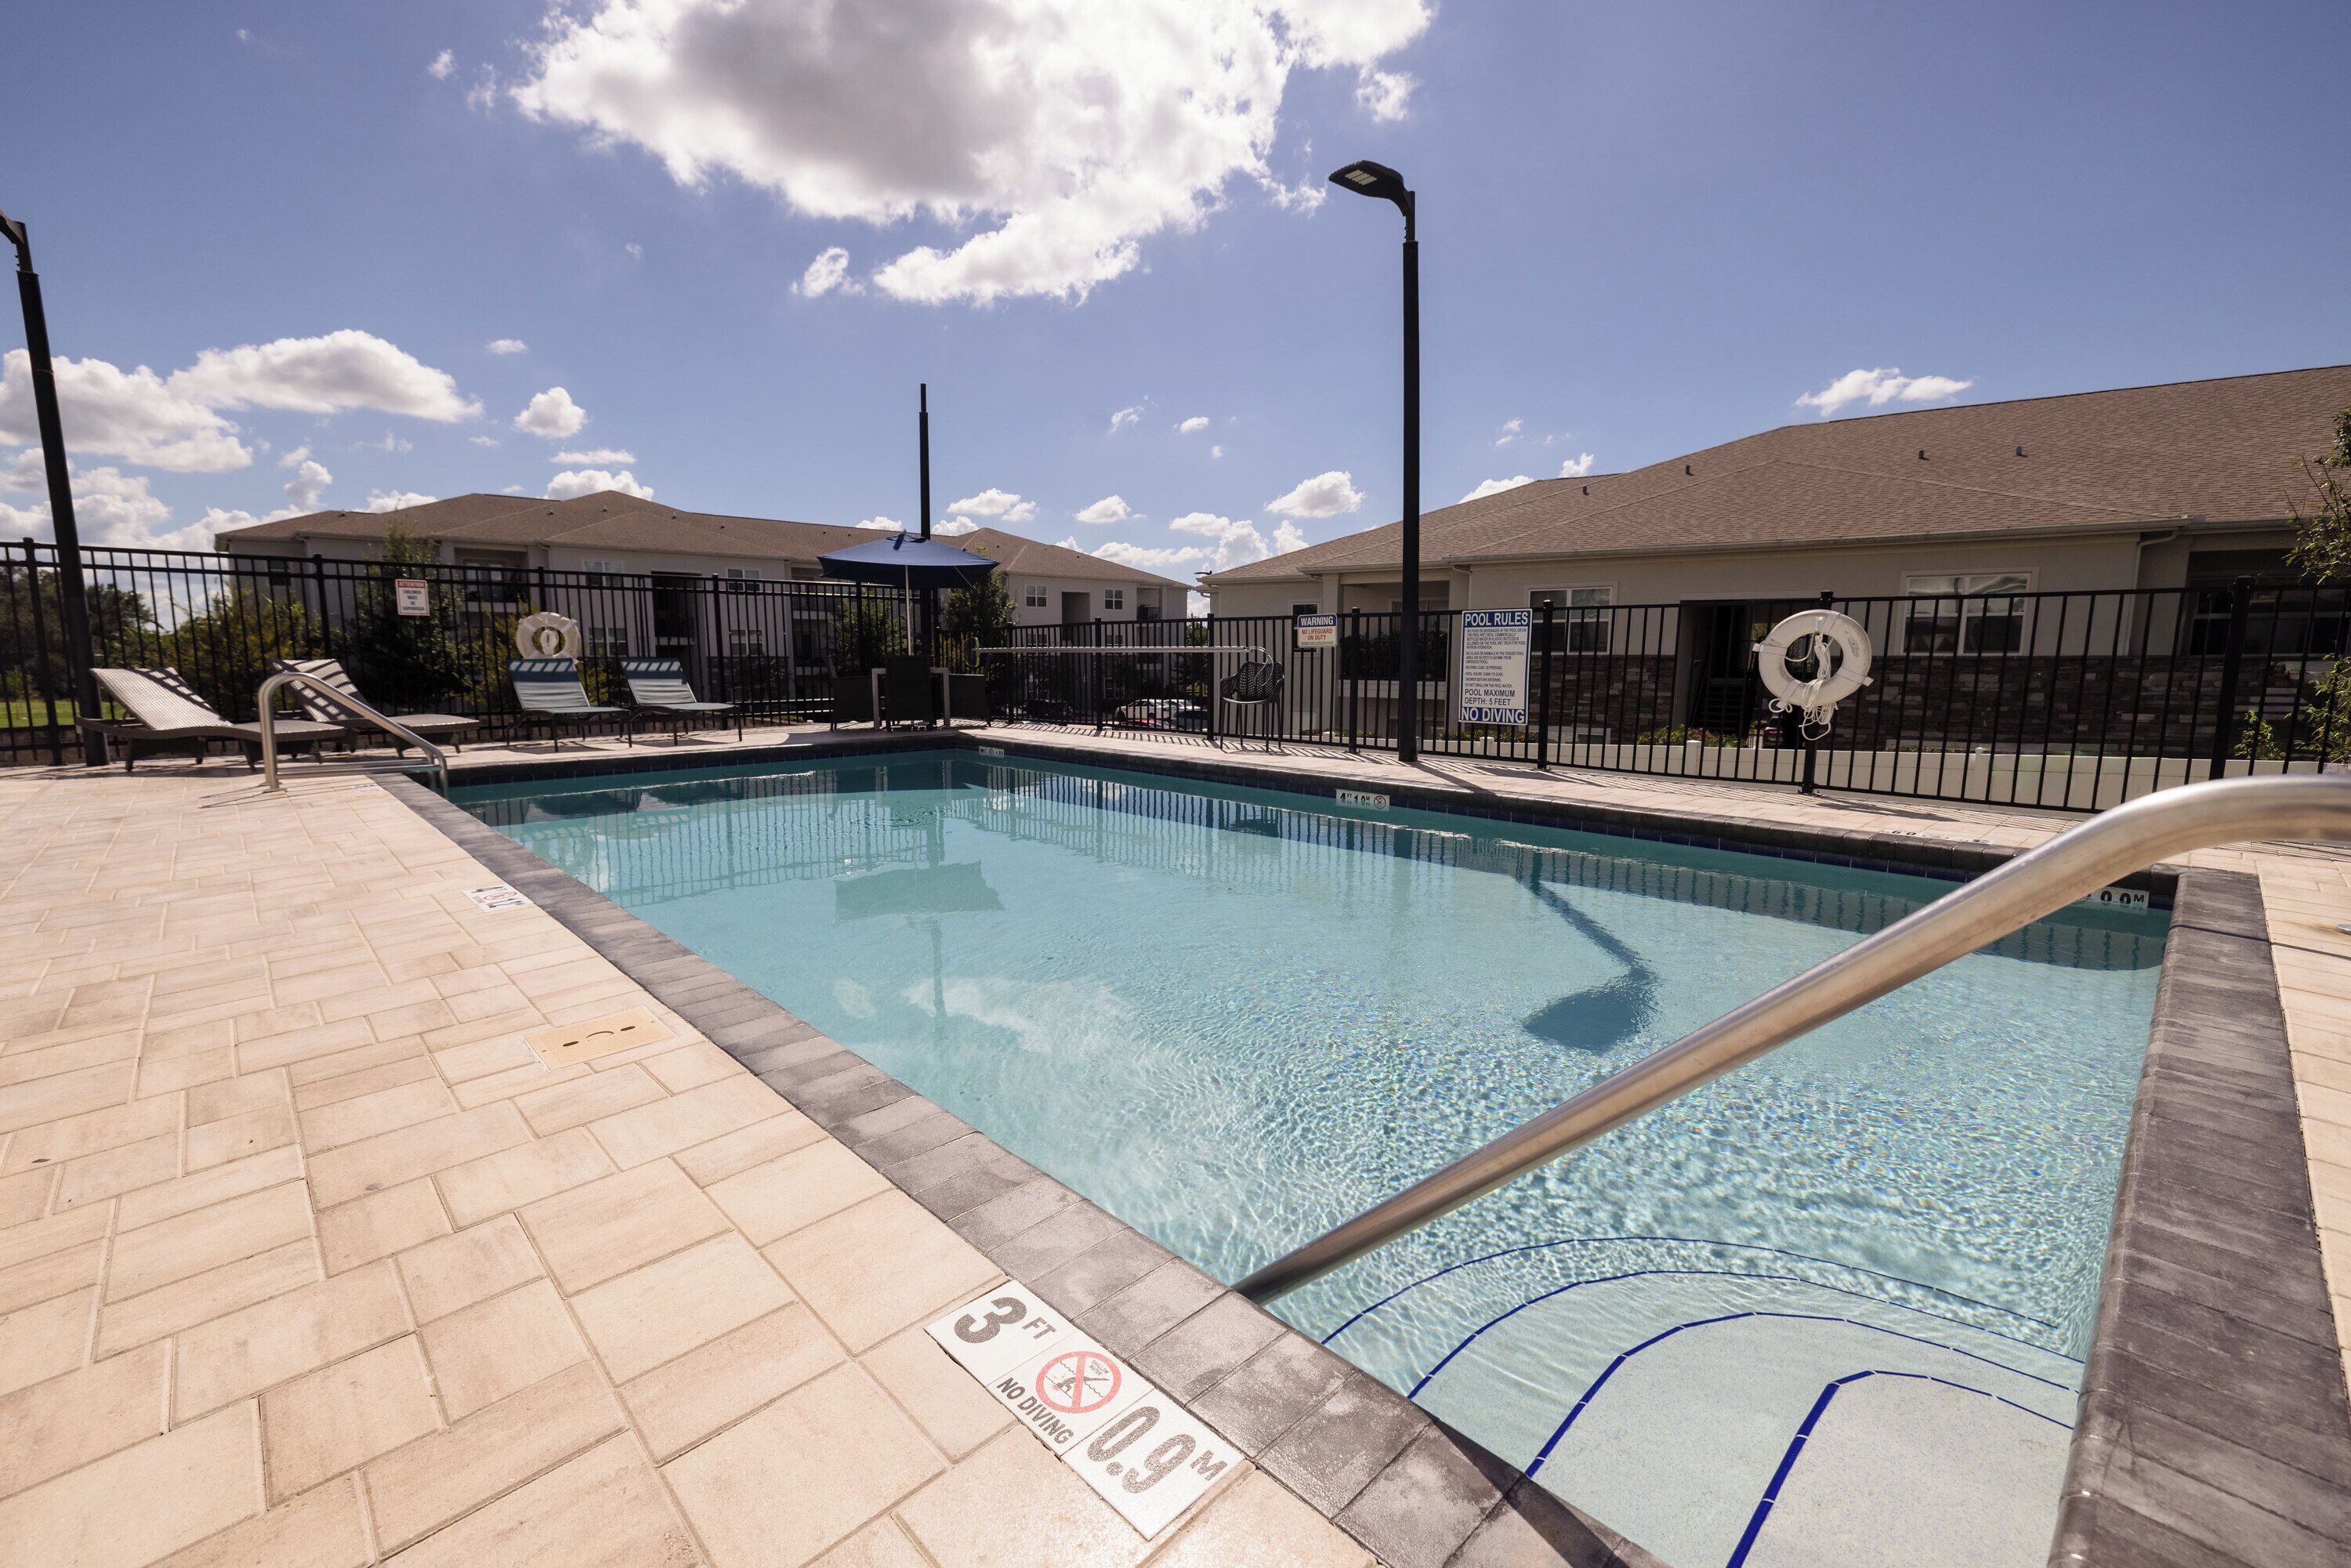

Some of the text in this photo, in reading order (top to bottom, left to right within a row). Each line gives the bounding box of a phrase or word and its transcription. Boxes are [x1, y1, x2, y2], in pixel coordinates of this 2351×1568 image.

[1301, 616, 1333, 626] WARNING
[1465, 612, 1528, 626] POOL RULES
[1461, 707, 1525, 723] NO DIVING
[953, 1296, 1058, 1344] 3 FT
[1089, 1364, 1102, 1376] WATER
[996, 1376, 1074, 1445] NO DIVING
[1087, 1406, 1228, 1494] 0.9 M
